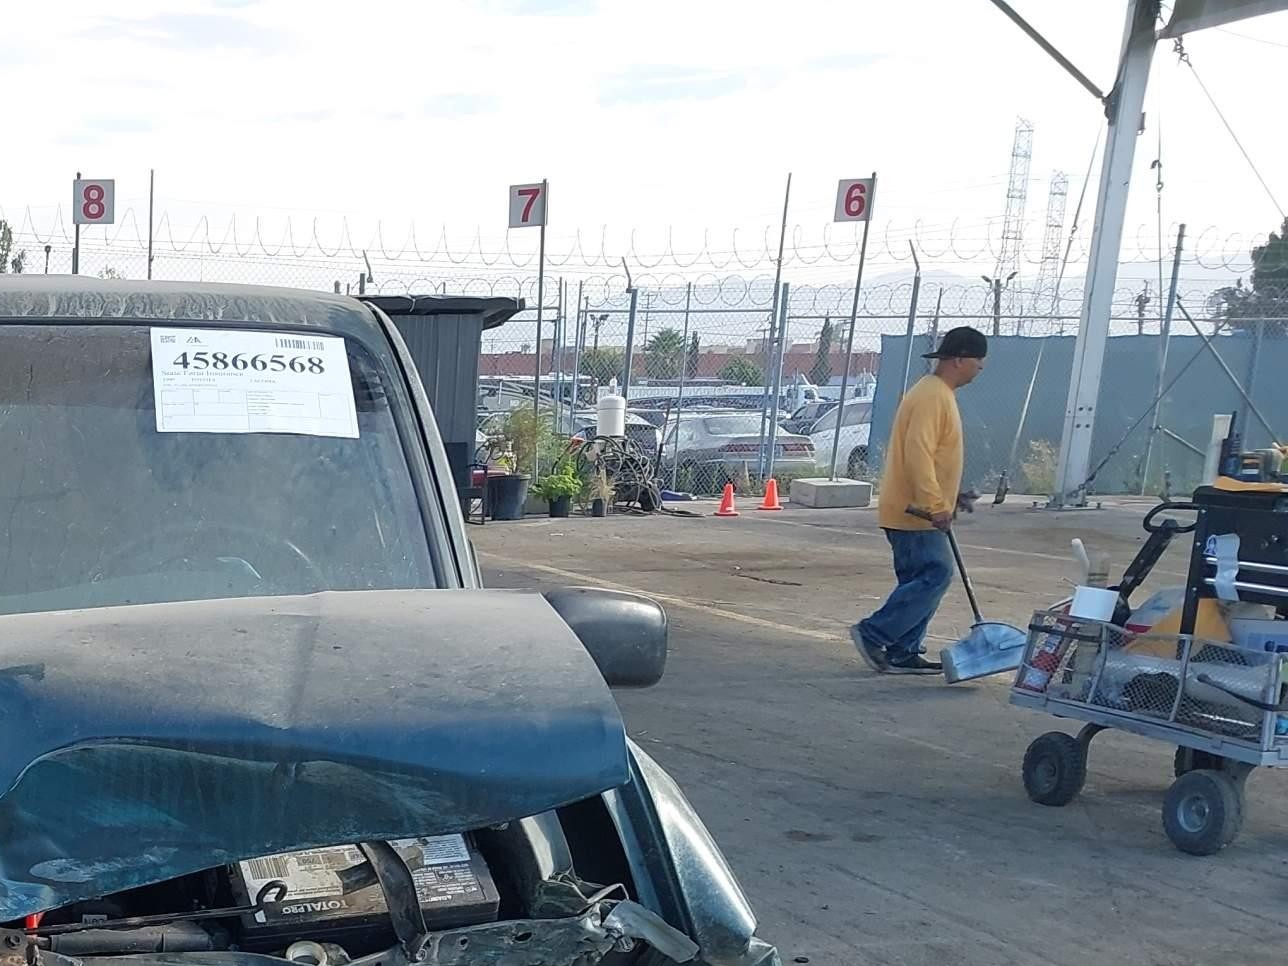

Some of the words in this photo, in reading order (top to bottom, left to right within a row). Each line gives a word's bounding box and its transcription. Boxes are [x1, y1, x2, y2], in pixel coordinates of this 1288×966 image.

[83, 184, 105, 220] 8
[518, 188, 540, 223] 7
[844, 183, 866, 217] 6
[172, 351, 326, 375] 45866568
[282, 899, 350, 914] TOTALPRO
